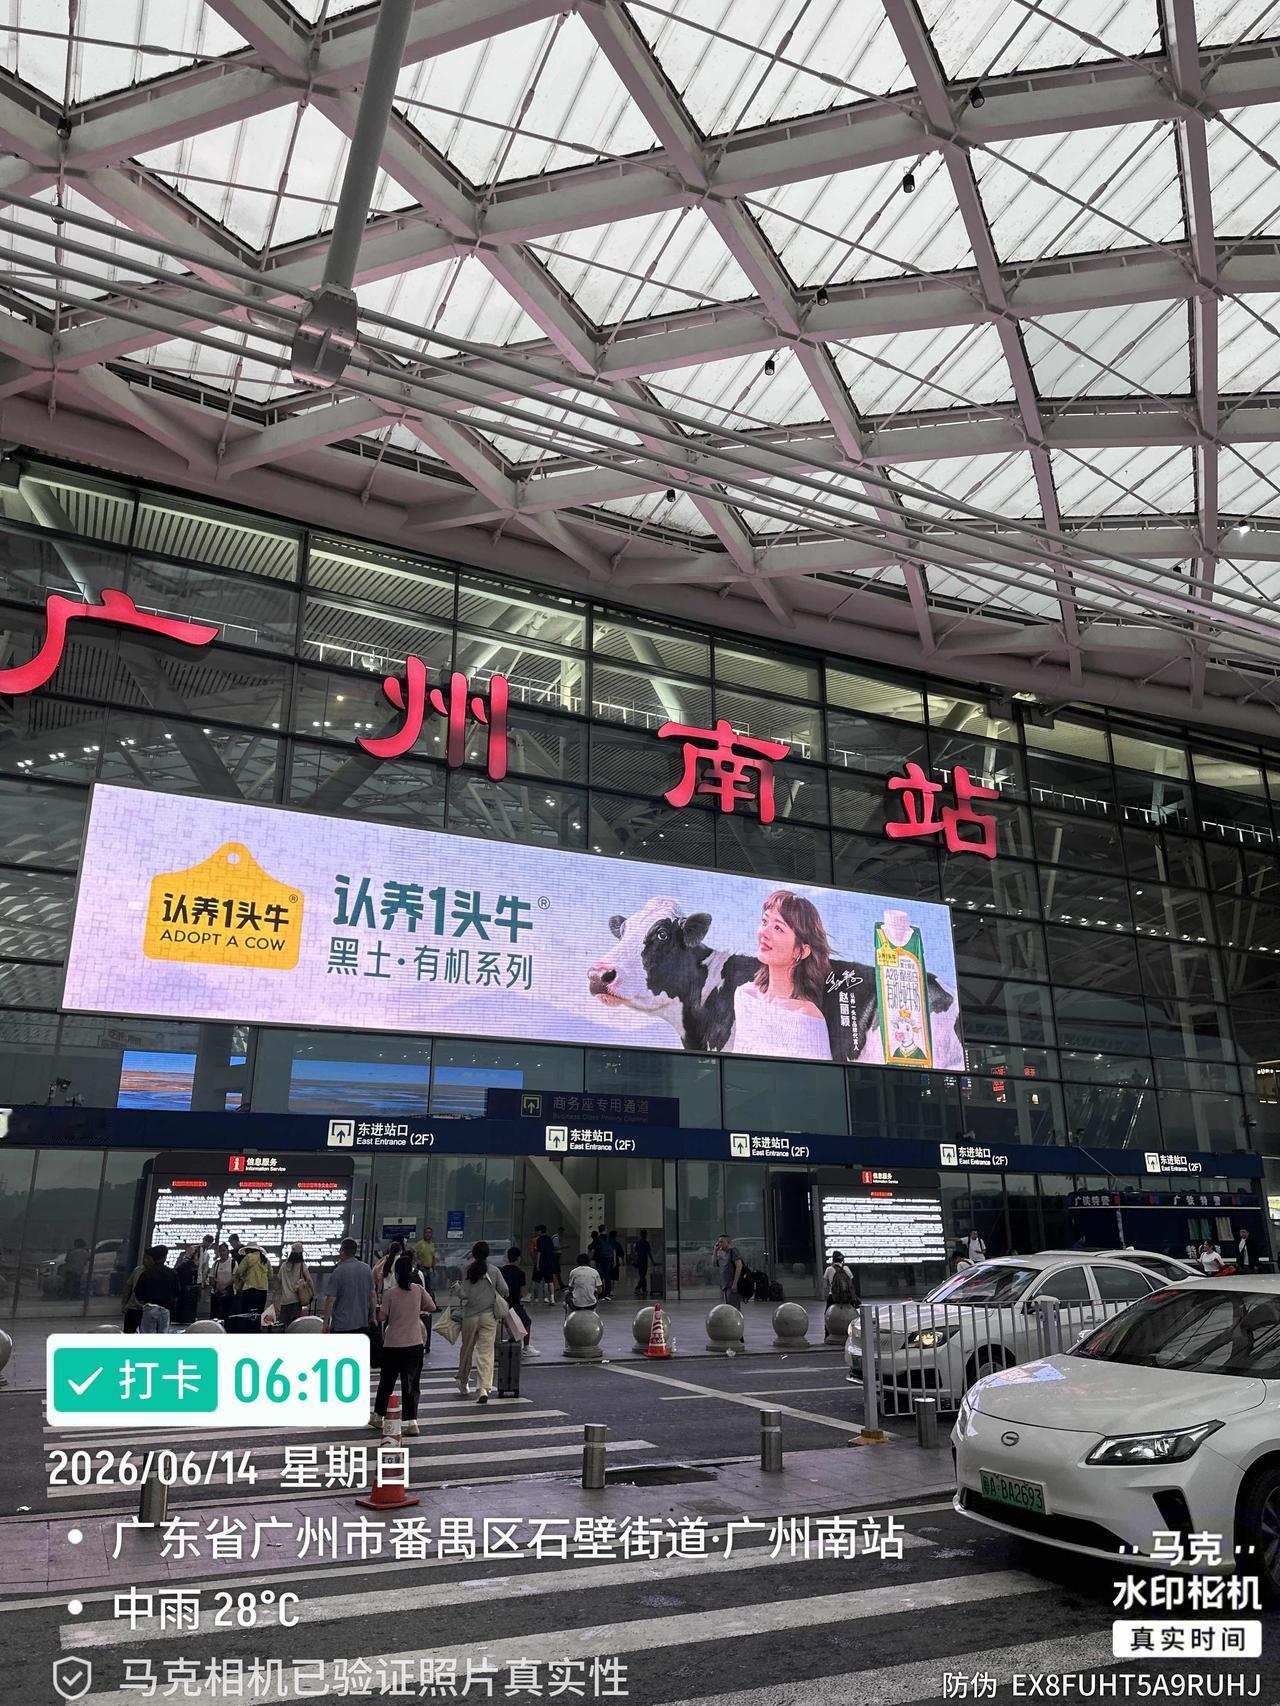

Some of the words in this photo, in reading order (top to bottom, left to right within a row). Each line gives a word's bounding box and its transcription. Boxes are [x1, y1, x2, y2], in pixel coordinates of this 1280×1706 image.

[0, 588, 1000, 859] 广州南站
[162, 893, 289, 932] 认养1头牛
[333, 874, 534, 944] 认养1头牛
[160, 929, 221, 945] ADOPT
[226, 935, 239, 948] A
[245, 936, 286, 951] COW
[327, 937, 533, 991] 黑土·有机系列
[553, 1096, 649, 1114] 商务座专用通道
[358, 1122, 409, 1136] 东进站口
[570, 1129, 613, 1142] 东进站口
[356, 1137, 373, 1145] East
[374, 1138, 407, 1146] Entrance
[410, 1133, 434, 1146] (2F)
[585, 1143, 612, 1151] Entrance
[614, 1139, 636, 1151] (2F)
[751, 1136, 790, 1149] 东进站口
[765, 1149, 789, 1157] Entrance
[791, 1146, 810, 1158] (2F)
[958, 1147, 991, 1158] 东进站口
[246, 1157, 278, 1166] 信息服务
[992, 1155, 1008, 1166] (2F)
